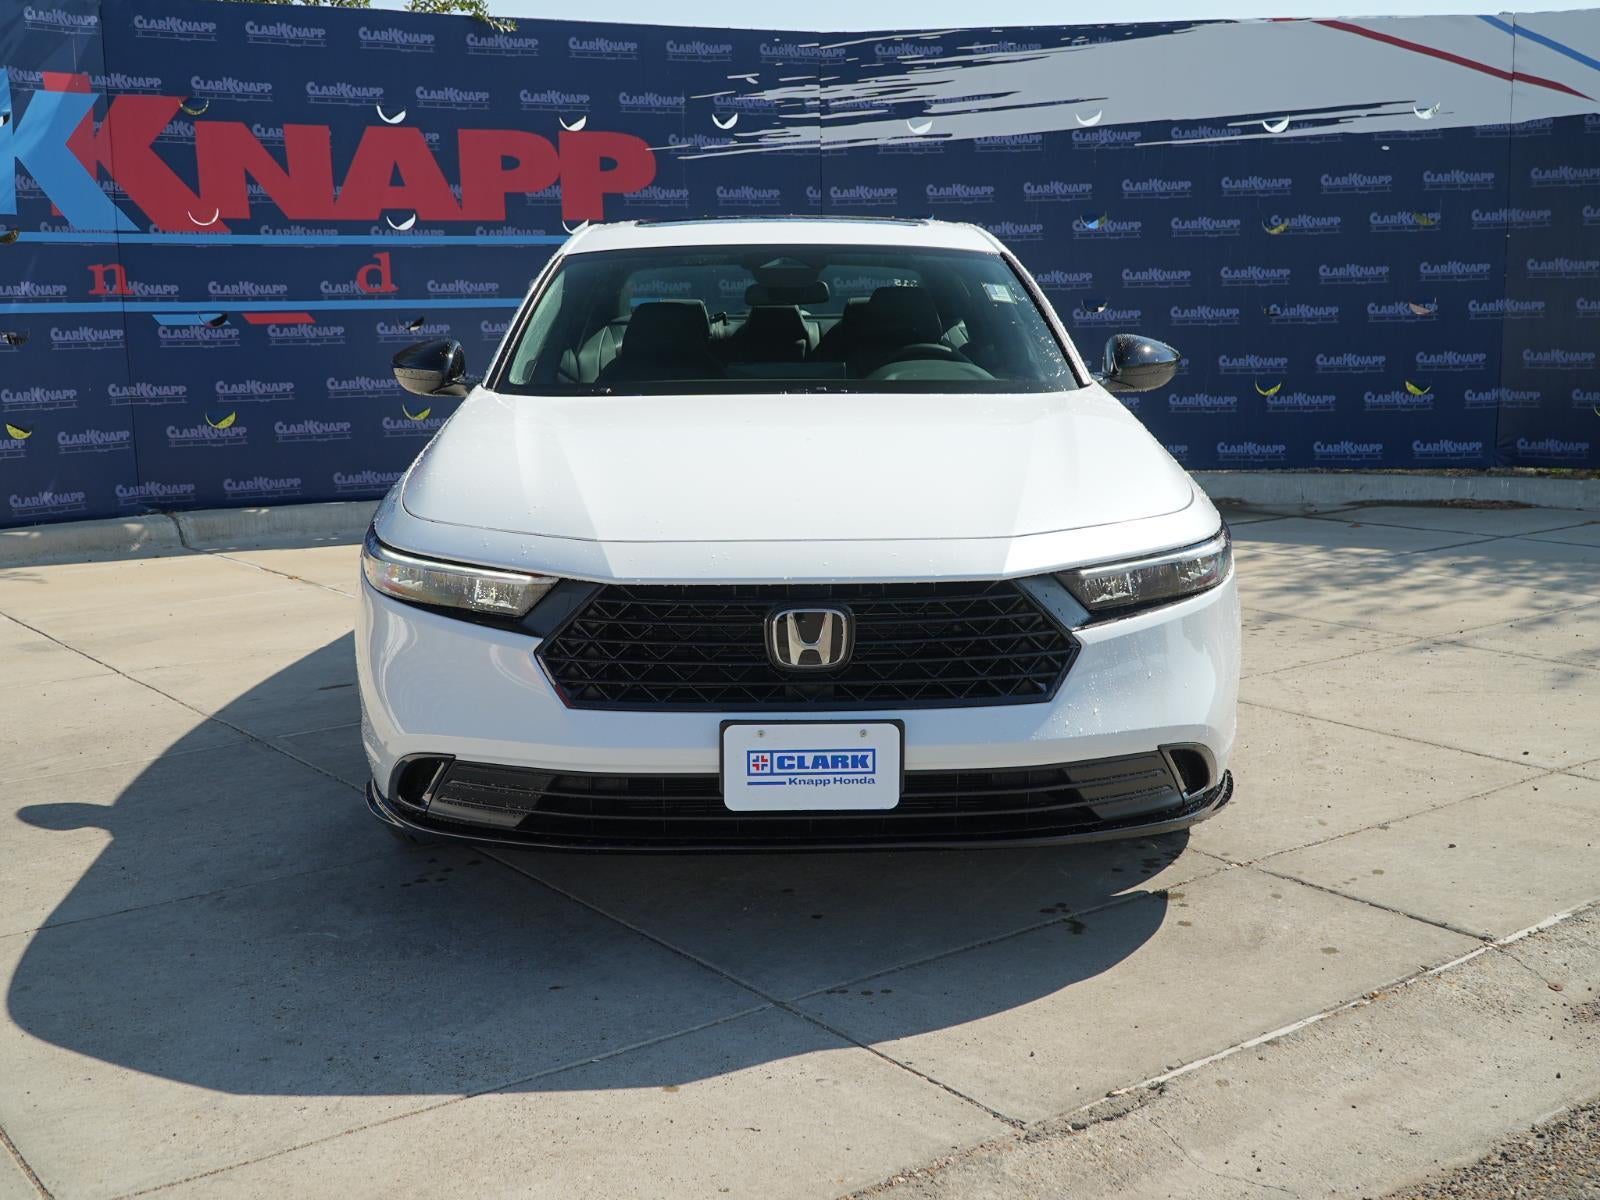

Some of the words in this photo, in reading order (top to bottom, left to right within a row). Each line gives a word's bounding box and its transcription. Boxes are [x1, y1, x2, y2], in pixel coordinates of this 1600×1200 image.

[43, 72, 656, 232] KNAPP
[776, 755, 870, 770] CLARK
[788, 777, 831, 787] Knapp
[833, 776, 876, 785] Honda
